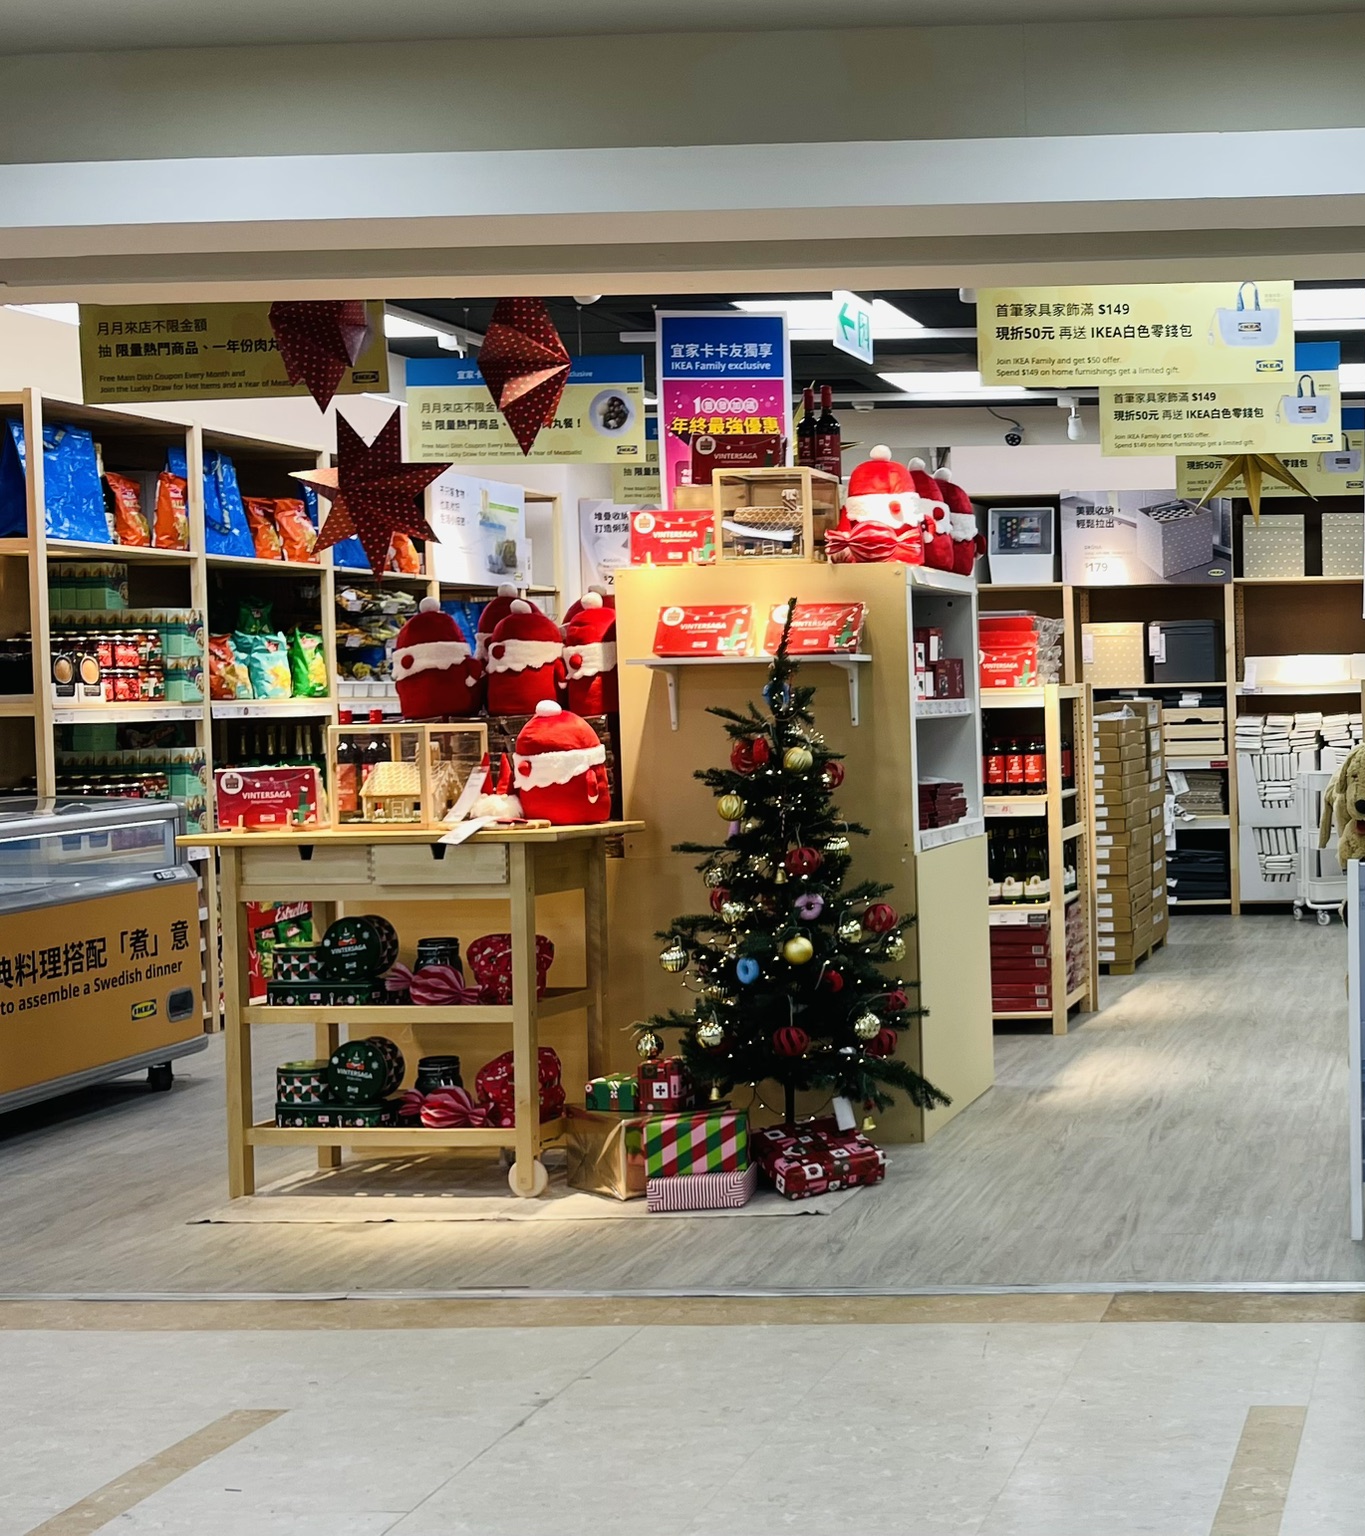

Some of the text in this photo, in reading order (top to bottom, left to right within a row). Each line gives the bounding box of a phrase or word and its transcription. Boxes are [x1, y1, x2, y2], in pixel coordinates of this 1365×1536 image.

[995, 303, 1130, 318] 首筆家具家飾滿 $149
[97, 318, 208, 336] 月月來店不限金額
[995, 324, 1193, 341] 現折50元 再送 IKEA白色零錢包
[99, 344, 112, 358] 抽
[670, 342, 773, 358] 宜家卡卡友獨享
[671, 360, 772, 373] IKEA Family exclusive
[1012, 357, 1030, 365] IKEA
[1031, 357, 1056, 366] Family
[1073, 357, 1086, 366] get
[1087, 356, 1101, 364] $50
[996, 368, 1020, 378] Spend
[1021, 368, 1039, 377] $149
[1051, 367, 1074, 376] home
[1075, 367, 1117, 377] furnishings
[1118, 368, 1131, 376] get
[1138, 366, 1164, 375] limited
[100, 375, 116, 383] Free
[155, 373, 183, 382] Coupon
[1191, 392, 1217, 402] $149
[1113, 410, 1159, 421] 現折50元
[671, 416, 781, 435] 年終最強優惠
[1140, 433, 1160, 441] Family
[714, 452, 758, 460] VINTERSAGA
[652, 530, 698, 539] VINTERSAGA
[1085, 562, 1108, 573] $179
[680, 621, 727, 631] VINTERSAGA
[982, 662, 1019, 670] VINTERSAGA
[241, 790, 292, 800] VINTERSAGA
[275, 900, 309, 923] Estrella
[330, 943, 368, 955] VINTERSAGA
[0, 960, 183, 1015] to assemble a Swedish dinner
